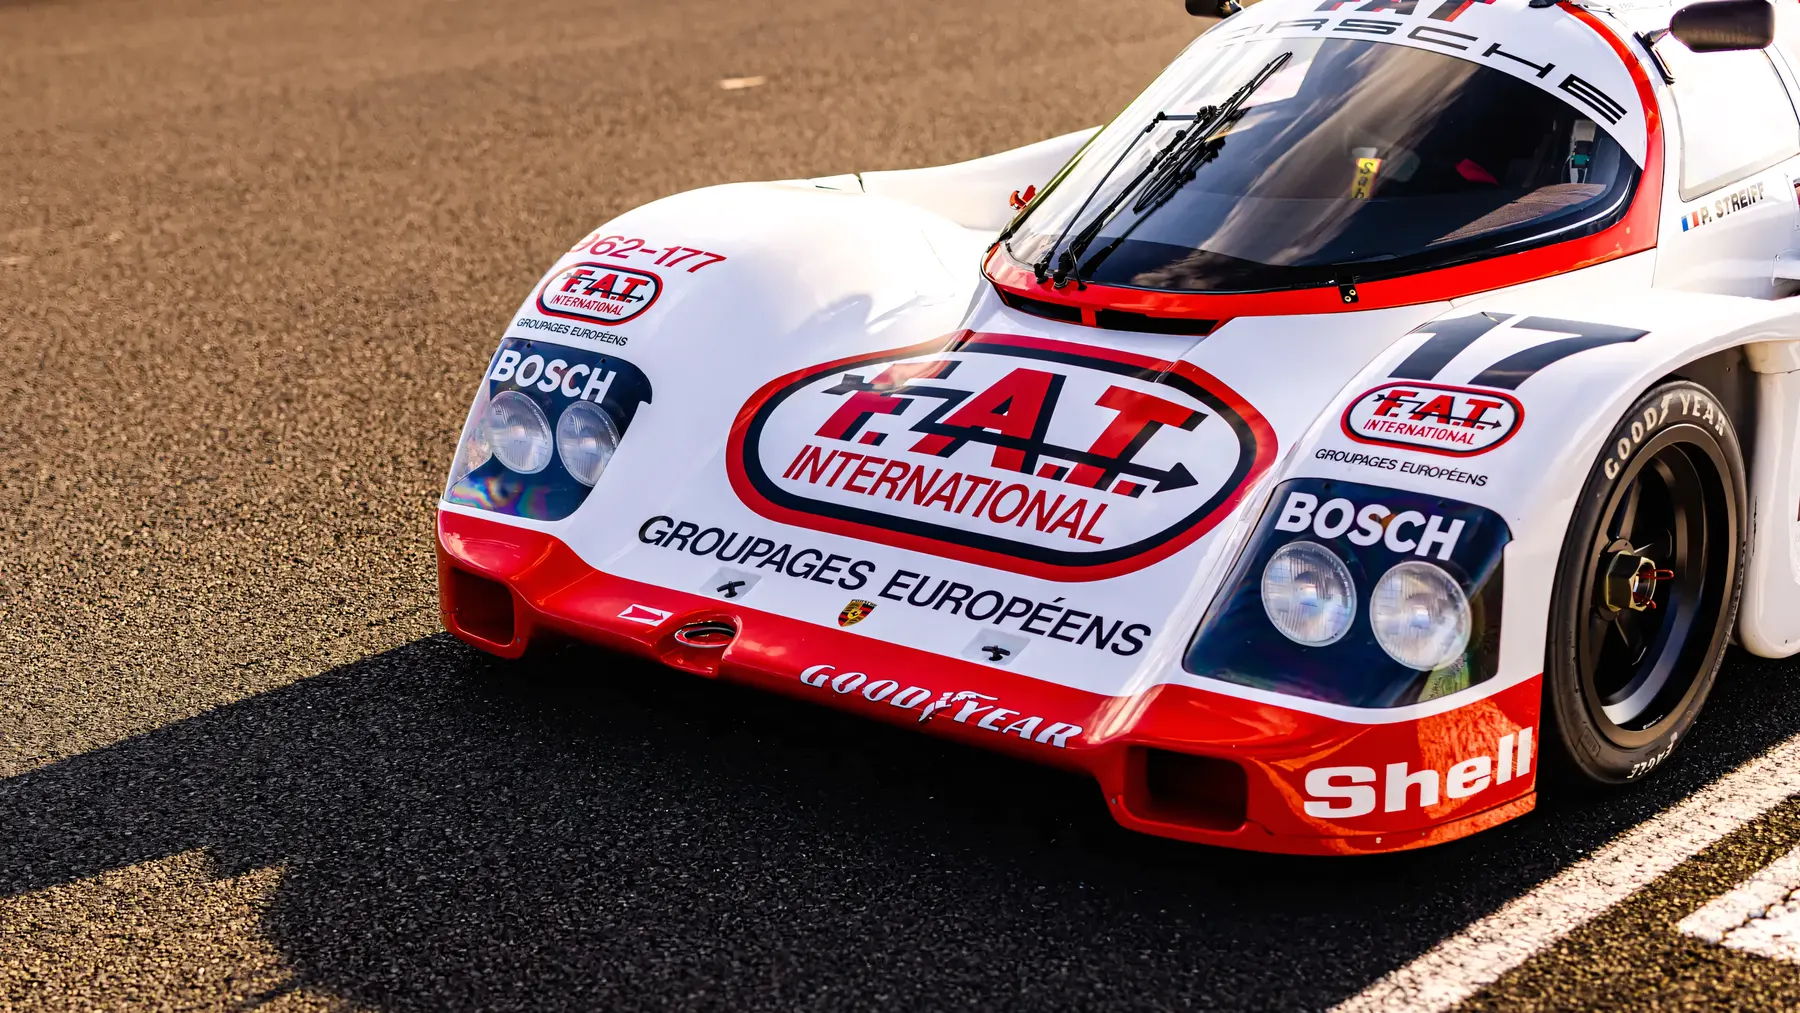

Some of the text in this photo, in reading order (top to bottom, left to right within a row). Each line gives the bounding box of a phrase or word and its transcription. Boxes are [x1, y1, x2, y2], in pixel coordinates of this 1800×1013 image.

[1700, 182, 1764, 225] P. STREIFF
[550, 294, 625, 316] INTERNATIONAL
[516, 317, 629, 347] GROUPAGES EUROPÉENS
[1388, 310, 1651, 390] 17
[489, 349, 617, 404] BOSCH
[1363, 418, 1476, 446] INTERNATIONAL
[1314, 448, 1489, 487] GROUPAGES EUROPÉENS
[782, 445, 1111, 545] INTERNATIONAL
[1274, 492, 1466, 562] BOSCH
[638, 515, 1152, 656] GROUPAGES EUROPÉENS
[1304, 726, 1534, 819] Shell
[1627, 742, 1673, 779] EAGLE
